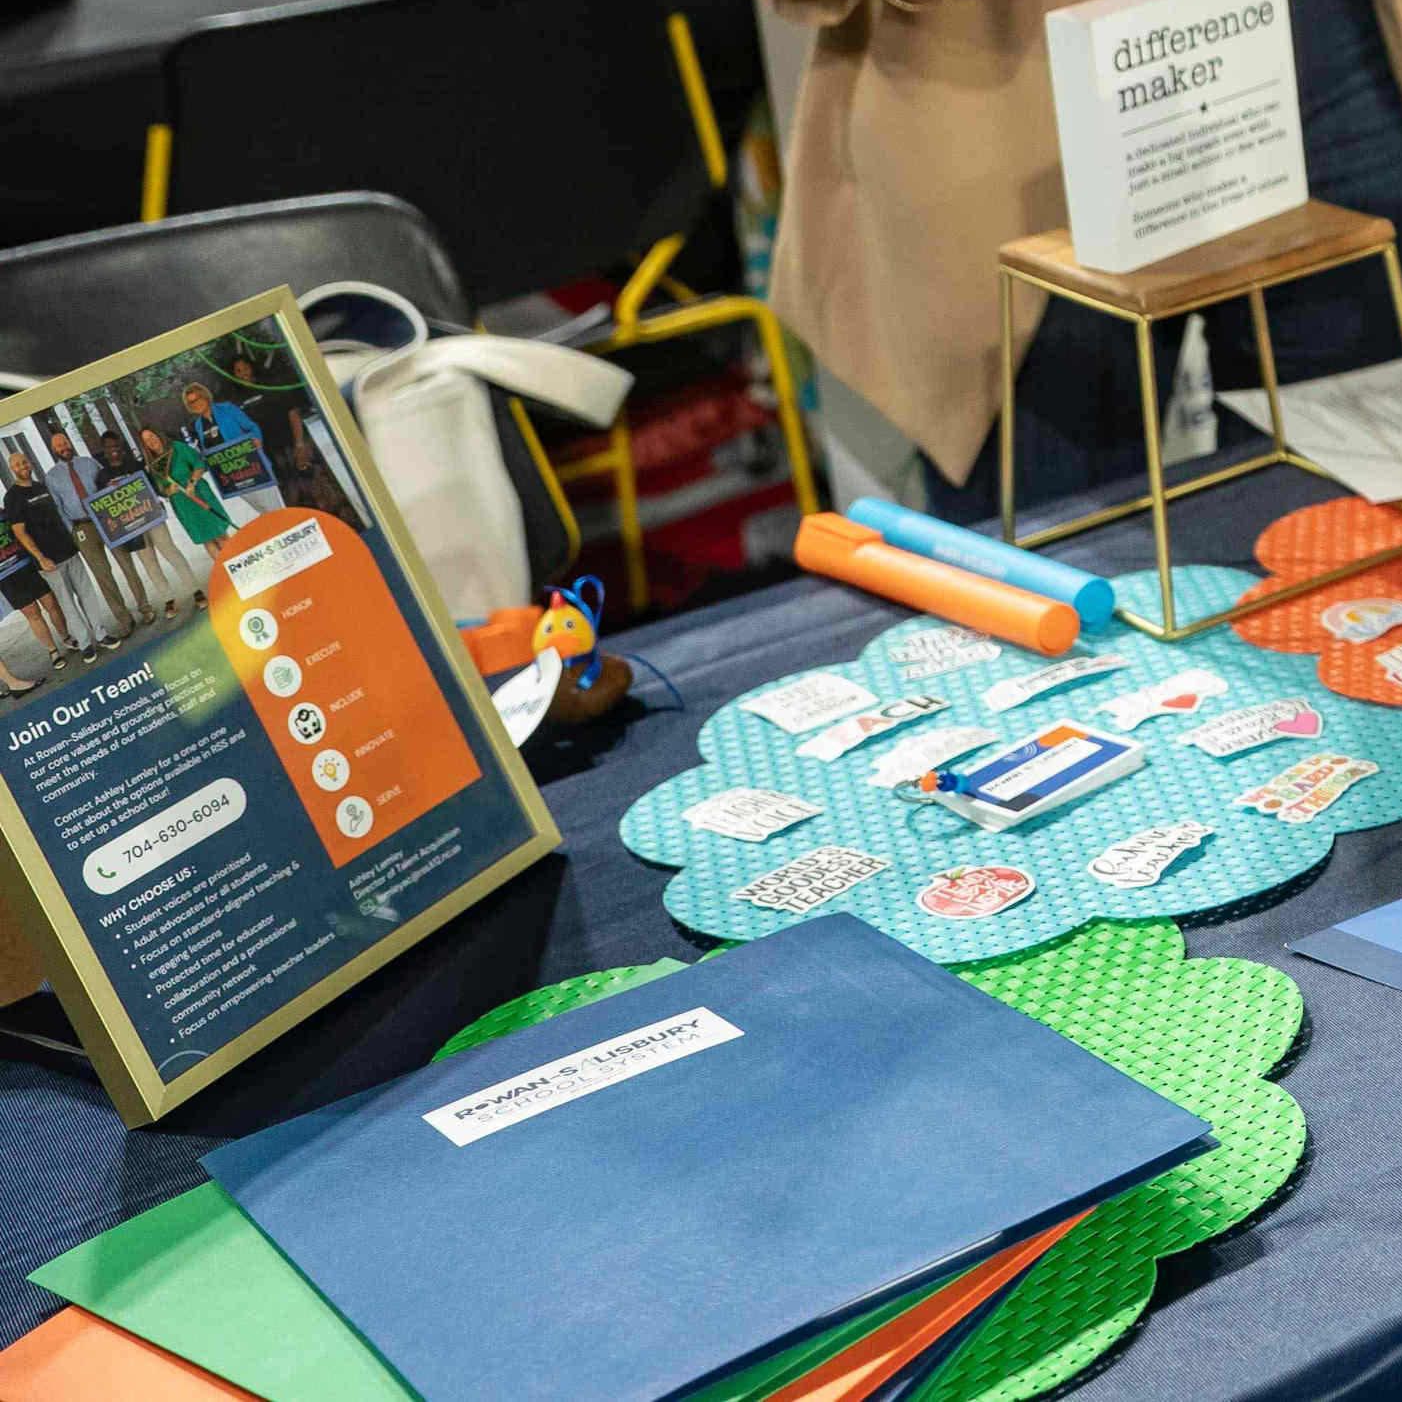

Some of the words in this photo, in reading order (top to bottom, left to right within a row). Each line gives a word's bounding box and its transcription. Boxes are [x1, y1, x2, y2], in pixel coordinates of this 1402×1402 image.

[1114, 0, 1275, 72] difference
[1119, 56, 1223, 113] maker
[90, 479, 146, 514] WELCOME
[109, 494, 141, 518] BACK
[8, 720, 52, 751] Join
[52, 697, 90, 725] Our
[91, 661, 154, 704] Team!
[23, 755, 36, 768] At
[34, 714, 113, 761] Rowan-Salisbury
[150, 687, 165, 699] we
[163, 674, 190, 691] focus
[189, 667, 202, 678] on
[29, 765, 46, 779] our
[47, 753, 70, 770] core
[69, 736, 101, 757] values
[100, 724, 120, 741] and
[119, 702, 165, 733] grounding
[163, 680, 206, 708] practices
[203, 675, 215, 684] to
[35, 772, 62, 791] meet
[61, 763, 79, 777] the
[79, 747, 109, 768] needs
[109, 739, 120, 751] of
[120, 732, 136, 745] our
[198, 687, 216, 703] and
[41, 768, 95, 803] community.
[53, 800, 94, 827] Contact
[93, 782, 125, 806] Ashley
[124, 764, 158, 788] Lemley
[157, 756, 171, 768] for
[179, 743, 197, 757] one
[196, 736, 210, 747] on
[209, 726, 226, 740] one
[60, 821, 84, 839] chat
[83, 805, 112, 826] about
[111, 796, 129, 810] the
[128, 776, 164, 800] options
[163, 755, 202, 781] available
[209, 738, 228, 754] RSS
[228, 728, 246, 744] and
[66, 840, 79, 851] to
[78, 829, 96, 844] set
[95, 822, 110, 835] up
[117, 798, 149, 822] school
[121, 793, 230, 863] 704-630-6094
[98, 905, 127, 927] WHY
[127, 877, 176, 910] CHOOSE
[123, 907, 163, 934] Student
[161, 889, 192, 912] voices
[192, 880, 207, 893] are
[207, 852, 251, 885] prioritized
[133, 929, 159, 950] Adult
[158, 901, 205, 934] advocates
[203, 891, 218, 905] for
[219, 883, 230, 896] all
[229, 861, 268, 890] students
[737, 847, 843, 899] WORLD'S
[757, 851, 865, 906] GOODEST
[783, 856, 889, 913] TEACHER
[139, 942, 169, 965] Focus
[168, 934, 182, 947] on
[181, 888, 256, 939] standard-aligned
[254, 865, 293, 893] teaching
[147, 949, 190, 979] engaging
[187, 928, 223, 954] lessons
[154, 960, 201, 994] Protected
[199, 948, 222, 965] time
[221, 939, 235, 952] for
[235, 913, 274, 943] educator
[163, 968, 222, 1009] collaboration
[220, 955, 239, 972] and
[245, 918, 297, 958] professional
[177, 1016, 207, 1039] Focus
[206, 1008, 220, 1020] on
[219, 972, 274, 1012] empowering
[271, 951, 304, 976] teacher
[303, 931, 336, 955] leaders
[171, 987, 221, 1024] community
[221, 963, 258, 991] network
[477, 1075, 595, 1122] SCHOOL
[598, 1032, 703, 1076] SYSTEM
